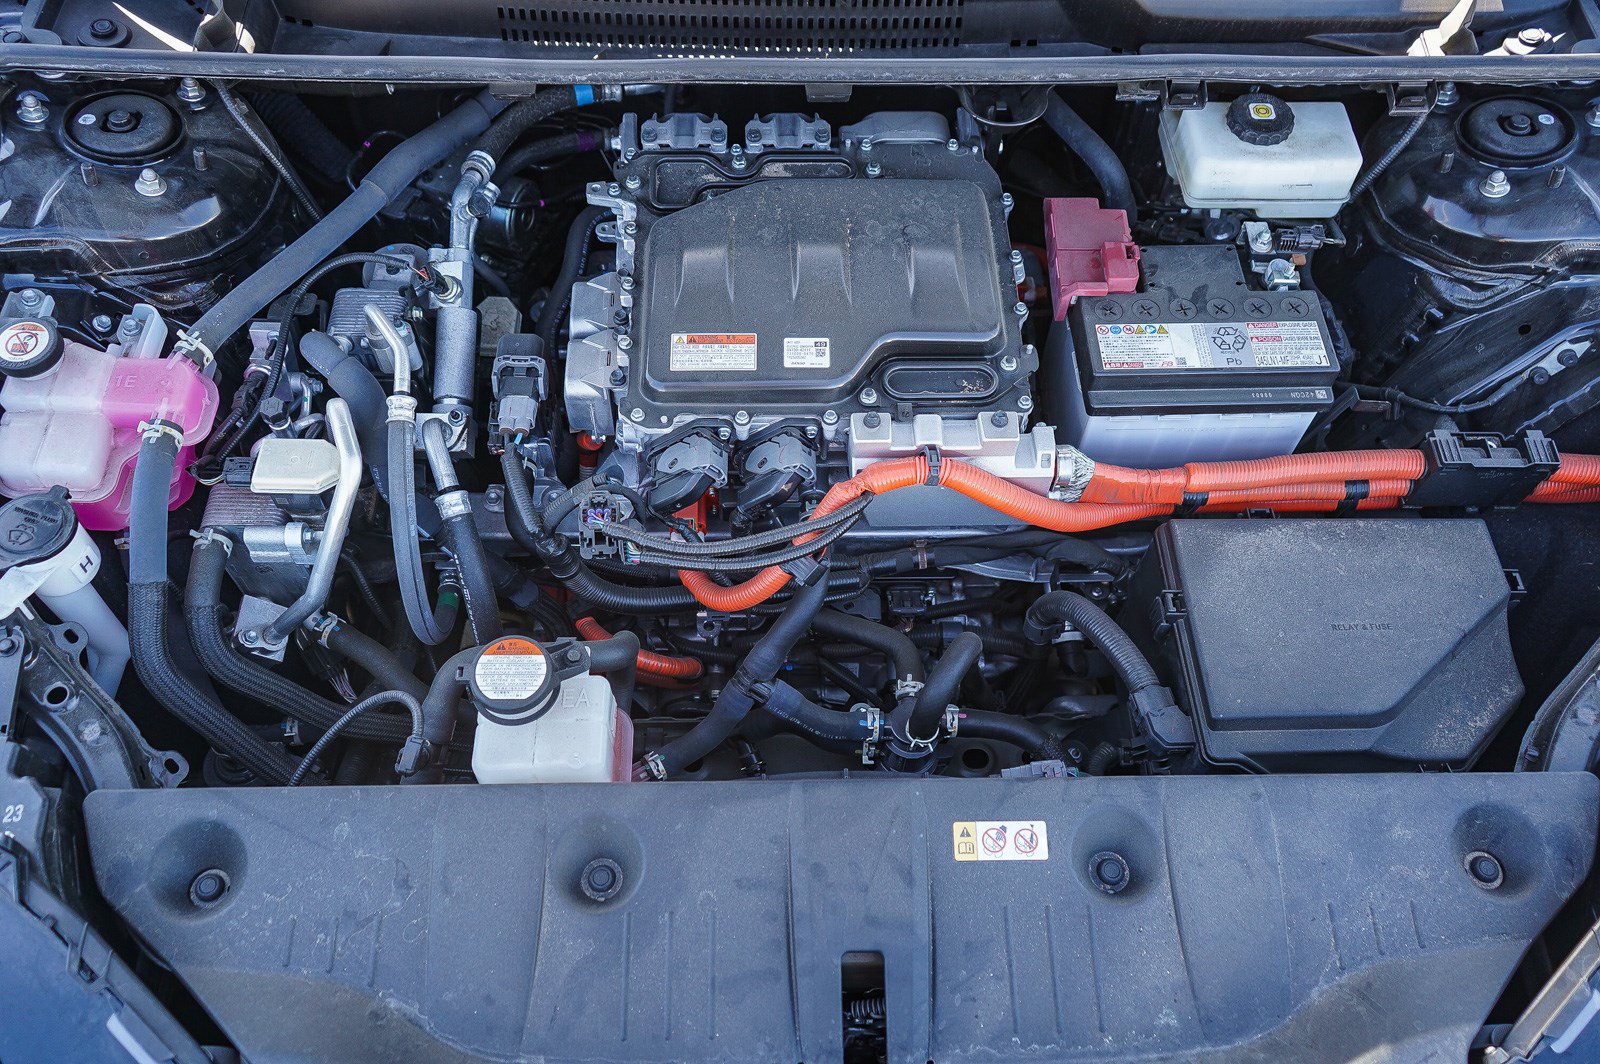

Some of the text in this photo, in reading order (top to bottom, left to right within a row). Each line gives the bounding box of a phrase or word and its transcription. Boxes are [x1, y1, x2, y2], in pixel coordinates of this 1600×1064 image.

[1226, 358, 1242, 366] Pb
[1316, 355, 1329, 365] J1
[80, 555, 93, 573] H
[1330, 623, 1358, 631] RELAY
[561, 688, 591, 709] EA
[3, 804, 24, 823] 23
